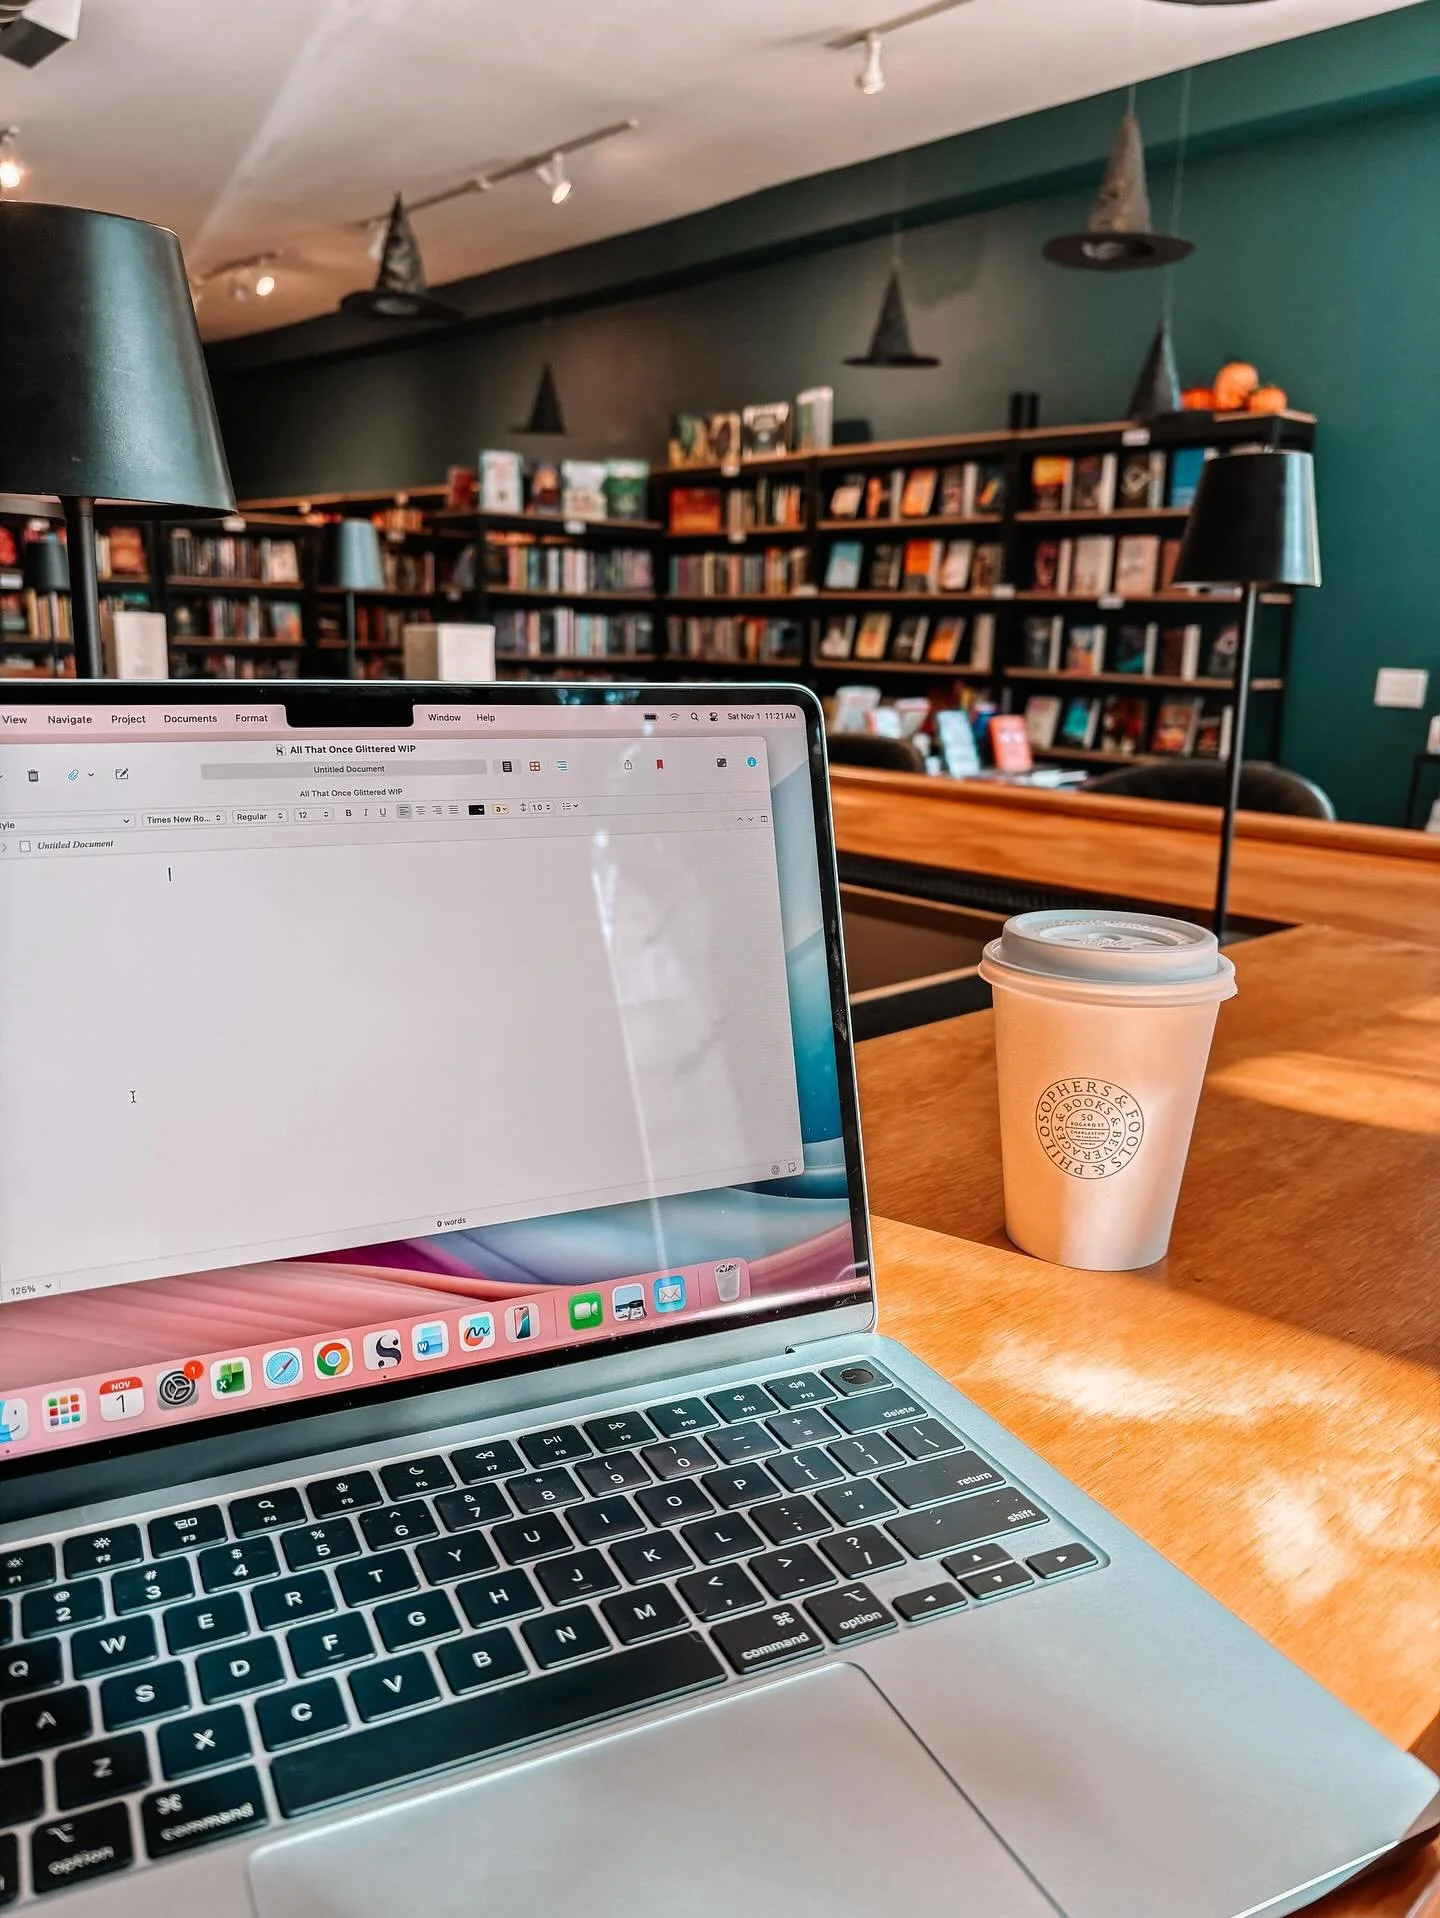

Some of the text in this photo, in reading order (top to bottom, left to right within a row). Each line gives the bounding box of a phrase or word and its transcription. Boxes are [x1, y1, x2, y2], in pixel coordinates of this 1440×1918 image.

[2, 713, 496, 725] View Navigate Project Documents Format Window Help
[290, 744, 416, 754] All That Once Glittered WIP
[312, 789, 329, 797] That
[353, 788, 387, 796] Glittered
[388, 788, 403, 796] WIP
[147, 816, 171, 824] Times
[174, 815, 191, 823] New
[237, 813, 267, 821] Regular
[298, 811, 308, 819] 12
[345, 809, 352, 817] B
[37, 840, 114, 849] Untitled Document
[1114, 1094, 1128, 1108] &
[1038, 1081, 1112, 1175] PHILOSOPHERS
[1054, 1098, 1122, 1160] BOOKS & BEVERAGES &
[1111, 1109, 1141, 1168] FOOLS
[1092, 1164, 1106, 1175] &
[444, 1217, 466, 1226] words
[11, 1284, 36, 1296] 125%
[112, 1380, 131, 1390] NOV
[219, 1379, 228, 1390] X
[116, 1394, 126, 1414] 1
[882, 1406, 915, 1418] delete
[677, 1458, 690, 1467] 0
[611, 1474, 624, 1483] 9
[733, 1479, 746, 1490] P
[956, 1471, 992, 1487] return
[542, 1490, 555, 1500] 8
[667, 1496, 682, 1506] O
[468, 1507, 481, 1517] 7
[600, 1513, 610, 1524] I
[1007, 1509, 1036, 1523] shift
[264, 1515, 276, 1523] F4
[395, 1526, 408, 1535] 6
[523, 1531, 540, 1542] U
[714, 1532, 732, 1542] L
[182, 1534, 196, 1542] F3
[316, 1544, 330, 1556] 5
[448, 1549, 461, 1562] Y
[642, 1549, 662, 1562] K
[96, 1554, 111, 1563] F2
[233, 1564, 248, 1576] 4
[368, 1569, 383, 1582] T
[571, 1569, 583, 1582] J
[8, 1575, 22, 1584] F1
[146, 1586, 161, 1599] 3
[285, 1591, 302, 1607] R
[489, 1590, 509, 1604] H
[56, 1607, 71, 1622] 2
[408, 1611, 426, 1626] G
[633, 1604, 657, 1620] M
[199, 1613, 214, 1629] E
[839, 1610, 882, 1631] option
[556, 1626, 577, 1643] N
[100, 1635, 126, 1654] W
[322, 1634, 338, 1651] F
[742, 1633, 808, 1659] command
[472, 1651, 492, 1667] B
[8, 1660, 29, 1676] Q
[230, 1660, 249, 1677] D
[383, 1675, 402, 1693] V
[135, 1685, 155, 1702] S
[291, 1703, 312, 1721] C
[36, 1712, 56, 1730] A
[193, 1729, 216, 1751] X
[93, 1757, 112, 1778] Z
[161, 1802, 254, 1841] command
[48, 1846, 114, 1874] option
